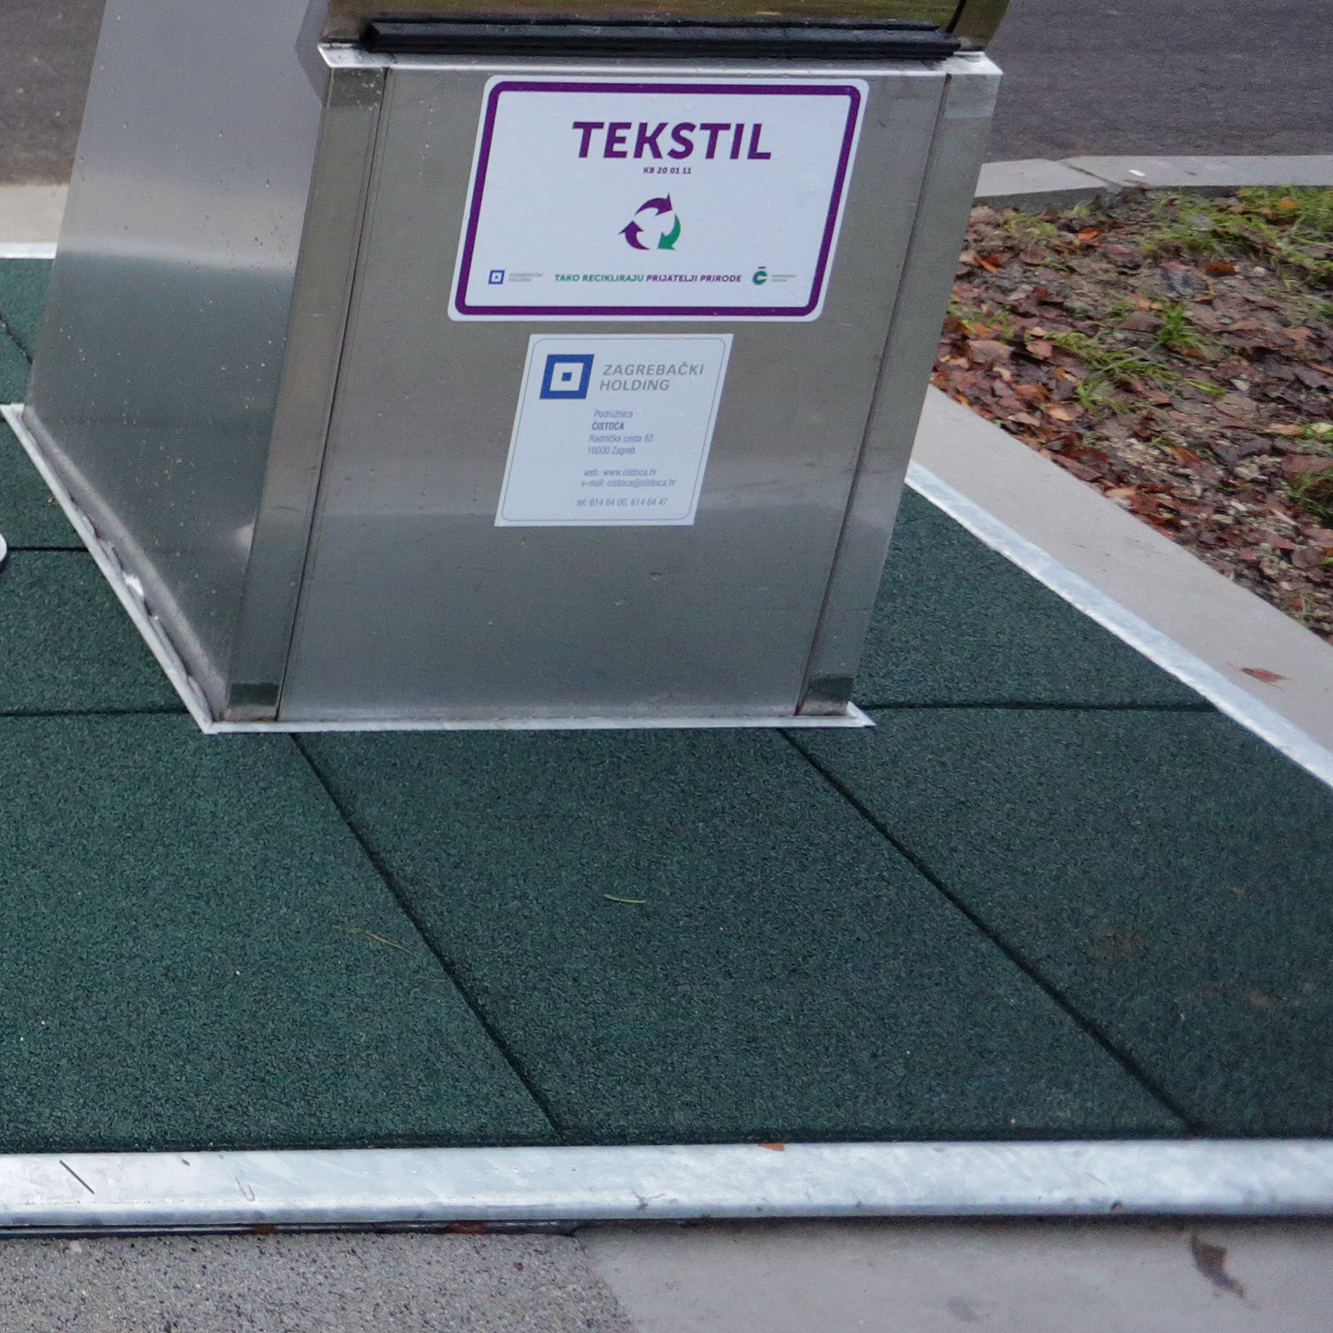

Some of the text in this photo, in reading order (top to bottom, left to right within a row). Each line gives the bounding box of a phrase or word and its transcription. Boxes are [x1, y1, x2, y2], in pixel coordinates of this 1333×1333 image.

[572, 121, 772, 160] TEKSTIL
[643, 166, 655, 175] KB
[656, 166, 668, 175] 20
[669, 166, 680, 175] 01
[554, 273, 580, 282] TAKO
[582, 274, 644, 282] RECIKLIRAJU
[646, 274, 698, 283] PRIJATELJI
[699, 274, 743, 283] PRIRODE
[602, 361, 705, 376] ZAGREBAČKI
[599, 379, 671, 392] HOLDING
